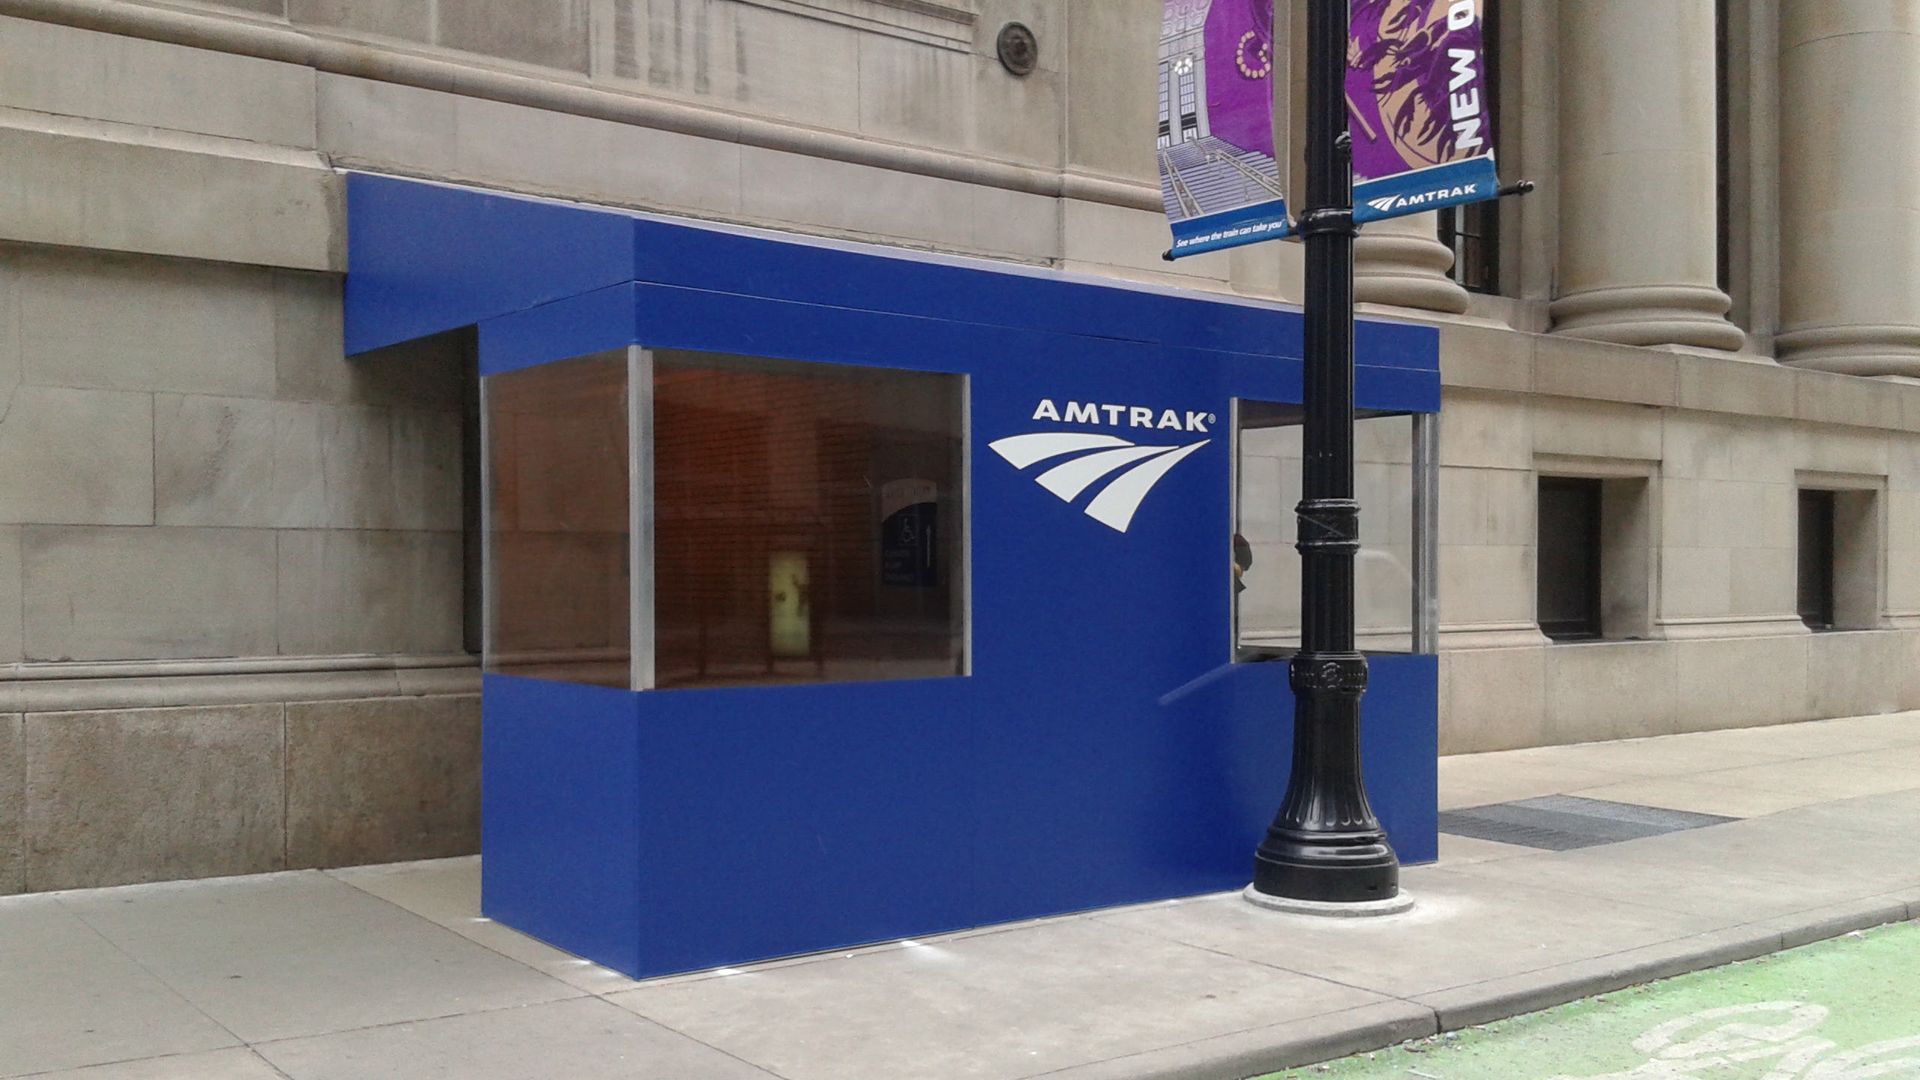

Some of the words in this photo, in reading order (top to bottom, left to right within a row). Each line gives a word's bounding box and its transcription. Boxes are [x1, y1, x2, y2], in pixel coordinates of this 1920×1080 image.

[1447, 48, 1483, 149] NEW
[1396, 183, 1476, 208] AMTRAK
[1176, 239, 1188, 248] See
[1189, 235, 1210, 245] where
[1211, 231, 1222, 241] the
[1223, 228, 1239, 238] train
[1239, 226, 1251, 235] can
[1252, 222, 1267, 232] take
